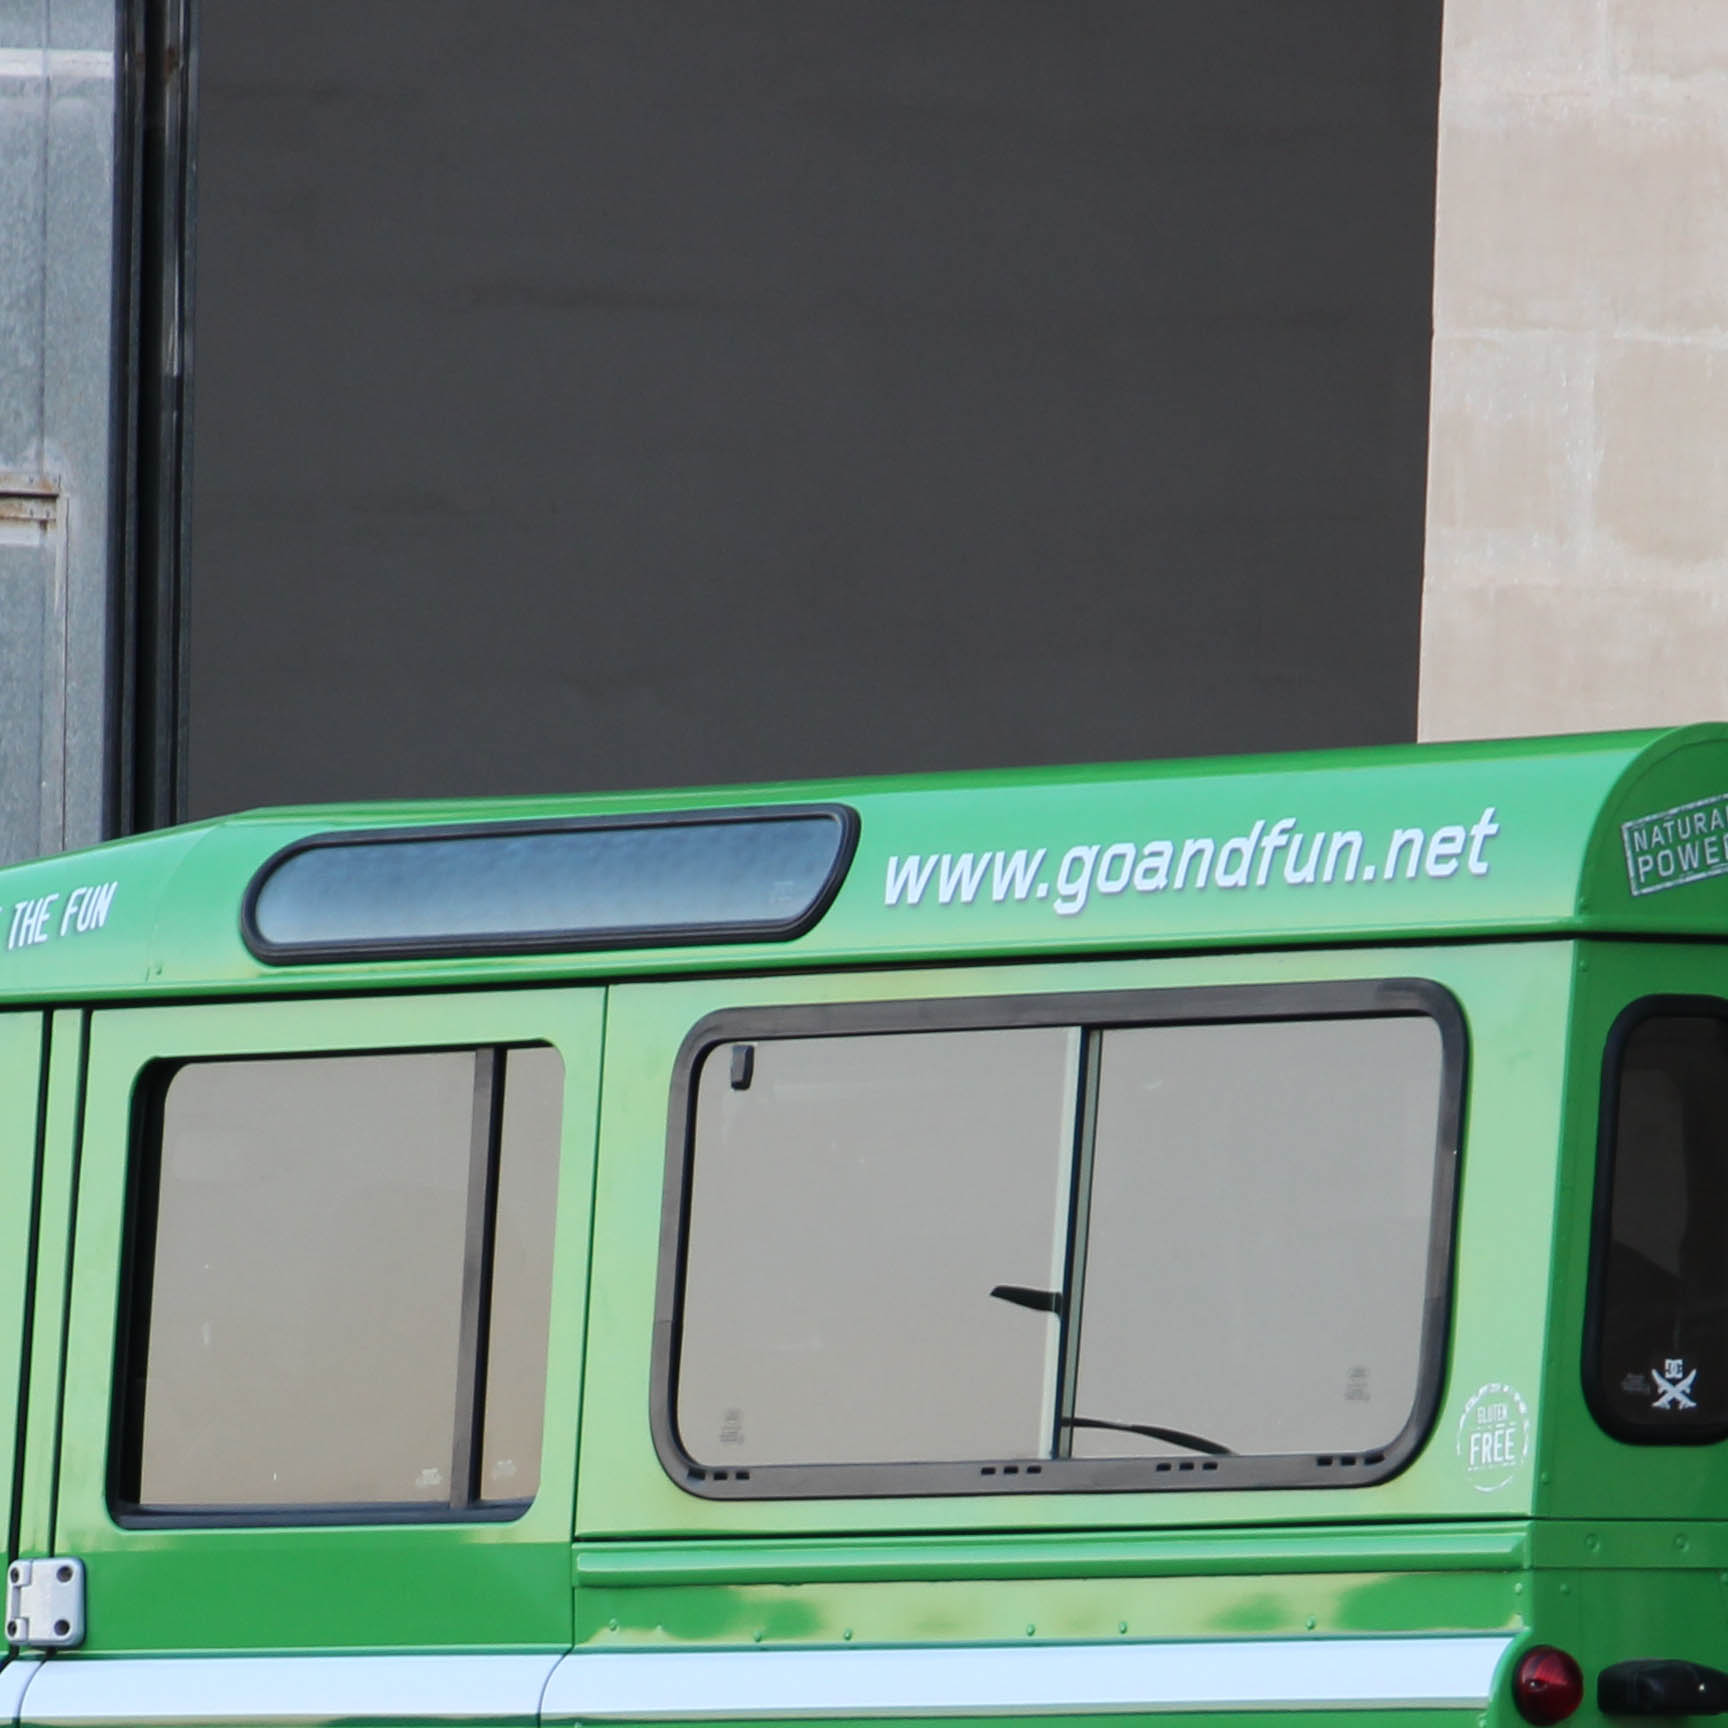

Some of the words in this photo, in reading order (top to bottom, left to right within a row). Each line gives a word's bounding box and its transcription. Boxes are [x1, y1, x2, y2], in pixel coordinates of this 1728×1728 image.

[883, 807, 1499, 916] www.goandfun.net
[8, 893, 60, 951] THE
[60, 881, 119, 937] FUN
[1470, 1428, 1515, 1465] FREE
